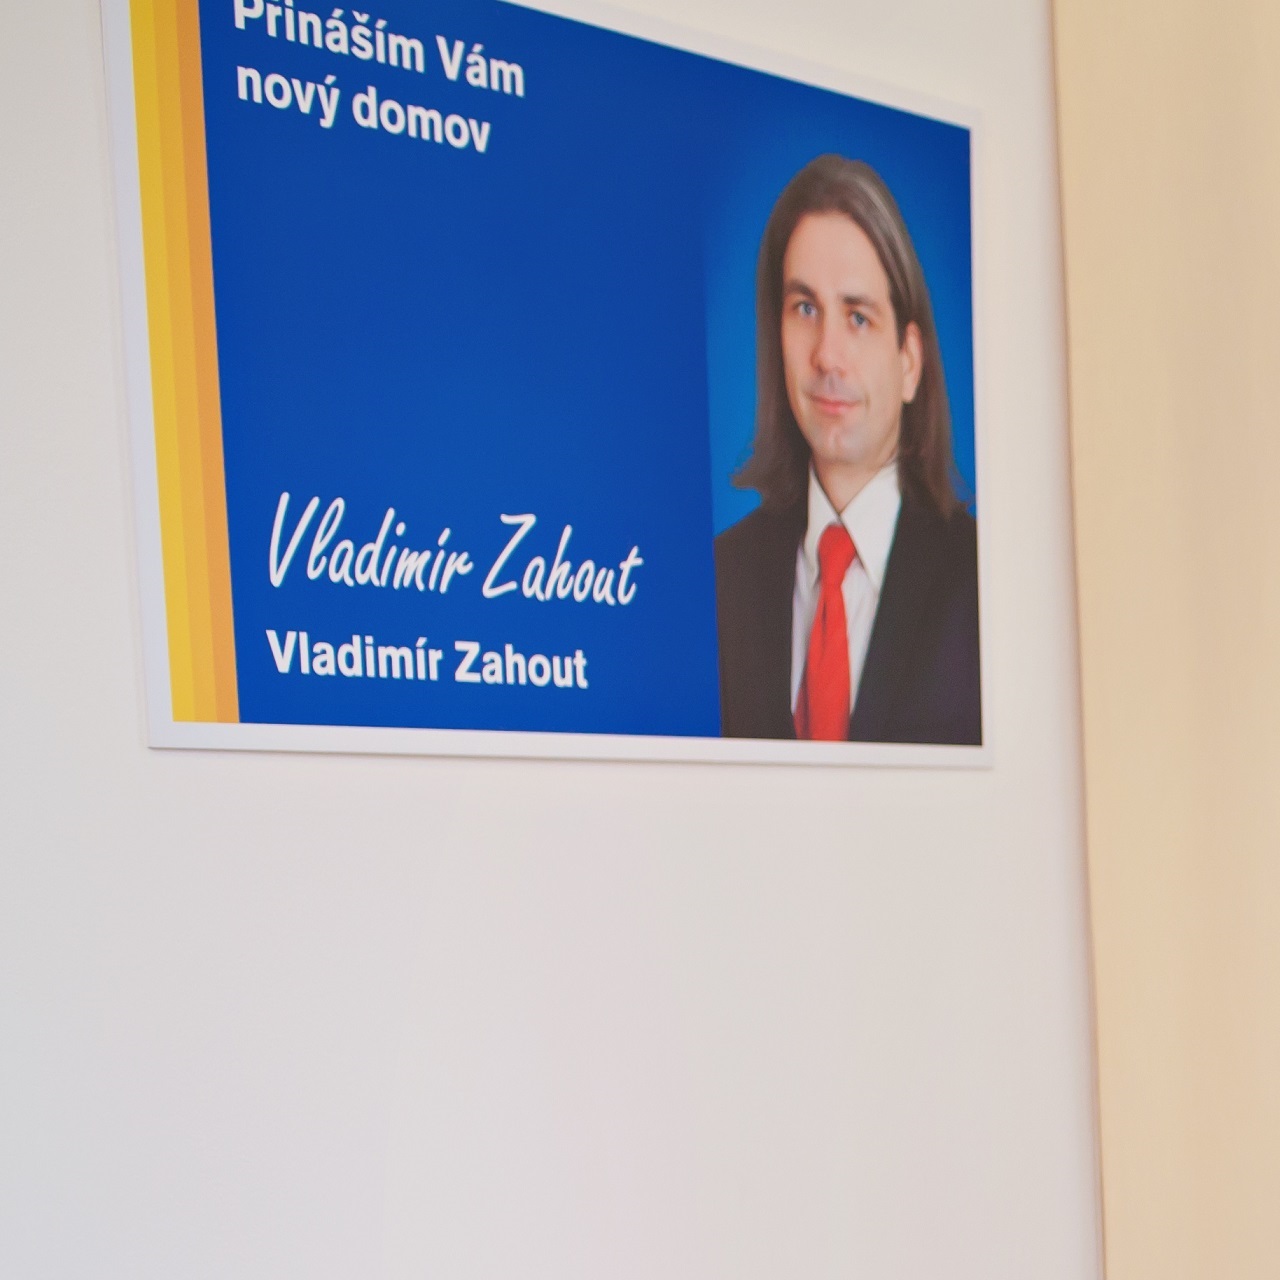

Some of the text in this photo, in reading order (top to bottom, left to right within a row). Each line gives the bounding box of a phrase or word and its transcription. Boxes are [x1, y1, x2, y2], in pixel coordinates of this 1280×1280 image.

[233, 0, 525, 97] Přináším Vám
[236, 65, 491, 153] nový domov
[268, 491, 644, 606] Vladimír Zahout
[265, 629, 589, 689] Vladimír Zahout
